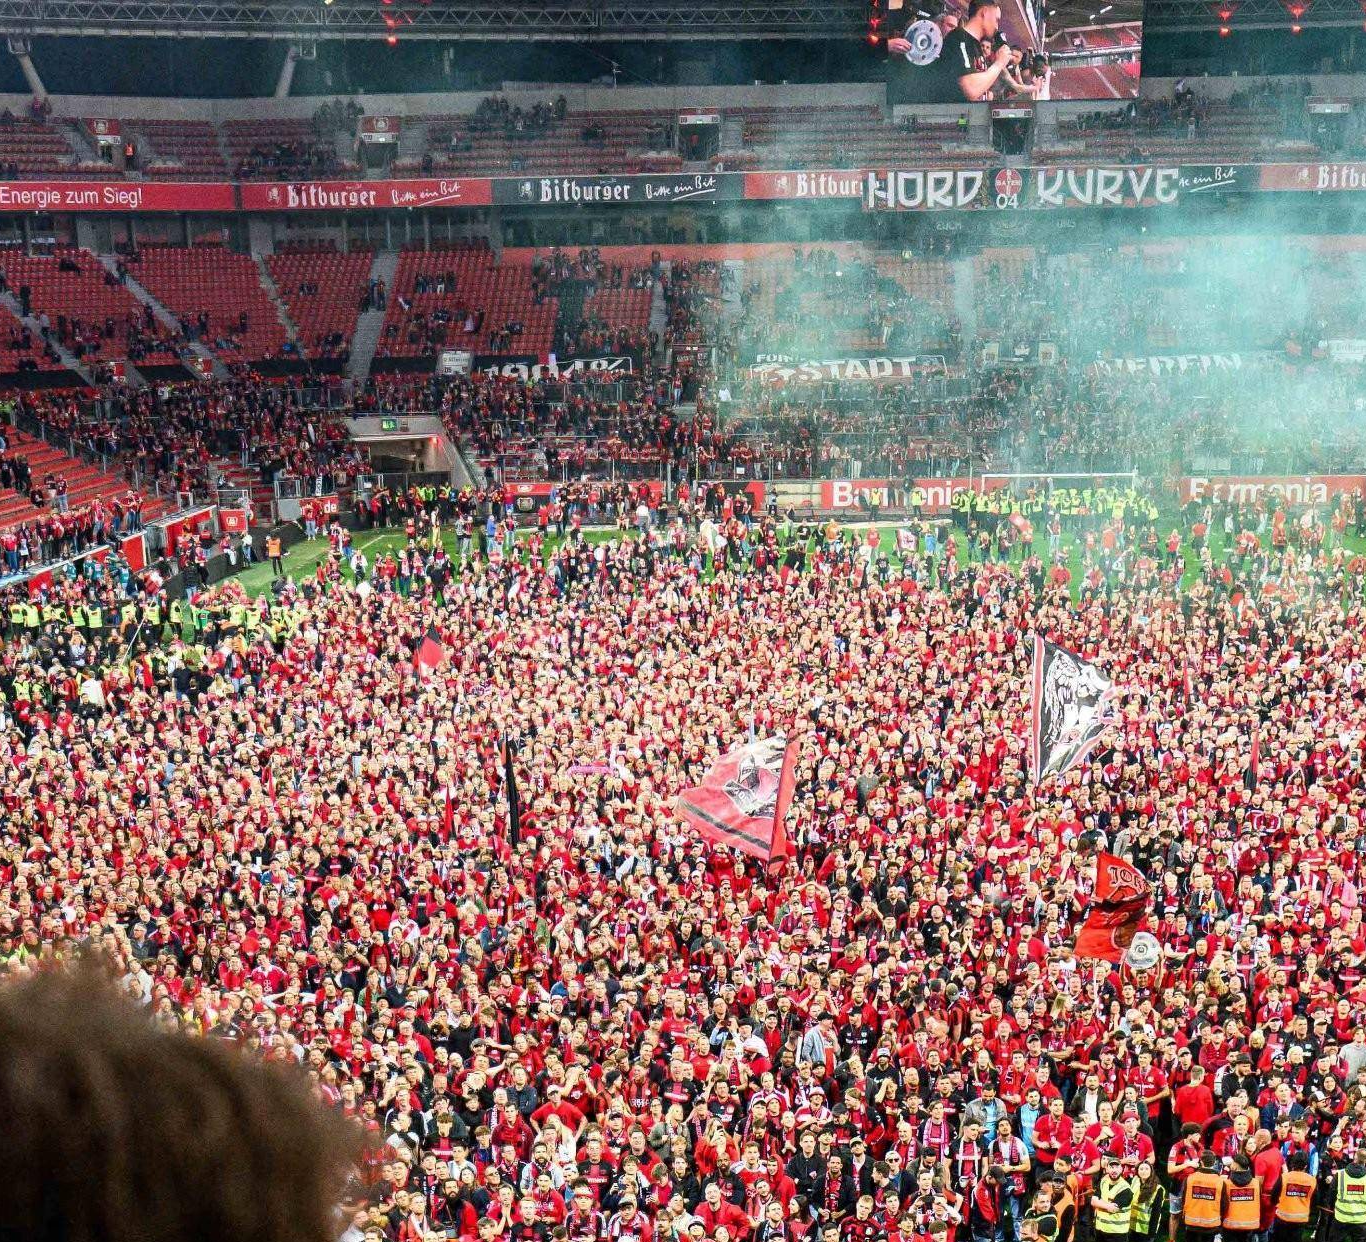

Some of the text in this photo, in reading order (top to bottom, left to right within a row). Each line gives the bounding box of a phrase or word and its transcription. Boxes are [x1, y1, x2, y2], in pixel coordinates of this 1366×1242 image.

[287, 185, 377, 207] Bitburger
[539, 178, 632, 202] Bitburger
[796, 174, 863, 197] Bitbur
[1037, 168, 1179, 204] KURVE
[64, 191, 94, 205] zum
[97, 187, 143, 208] Sieg!
[996, 193, 1019, 210] 04
